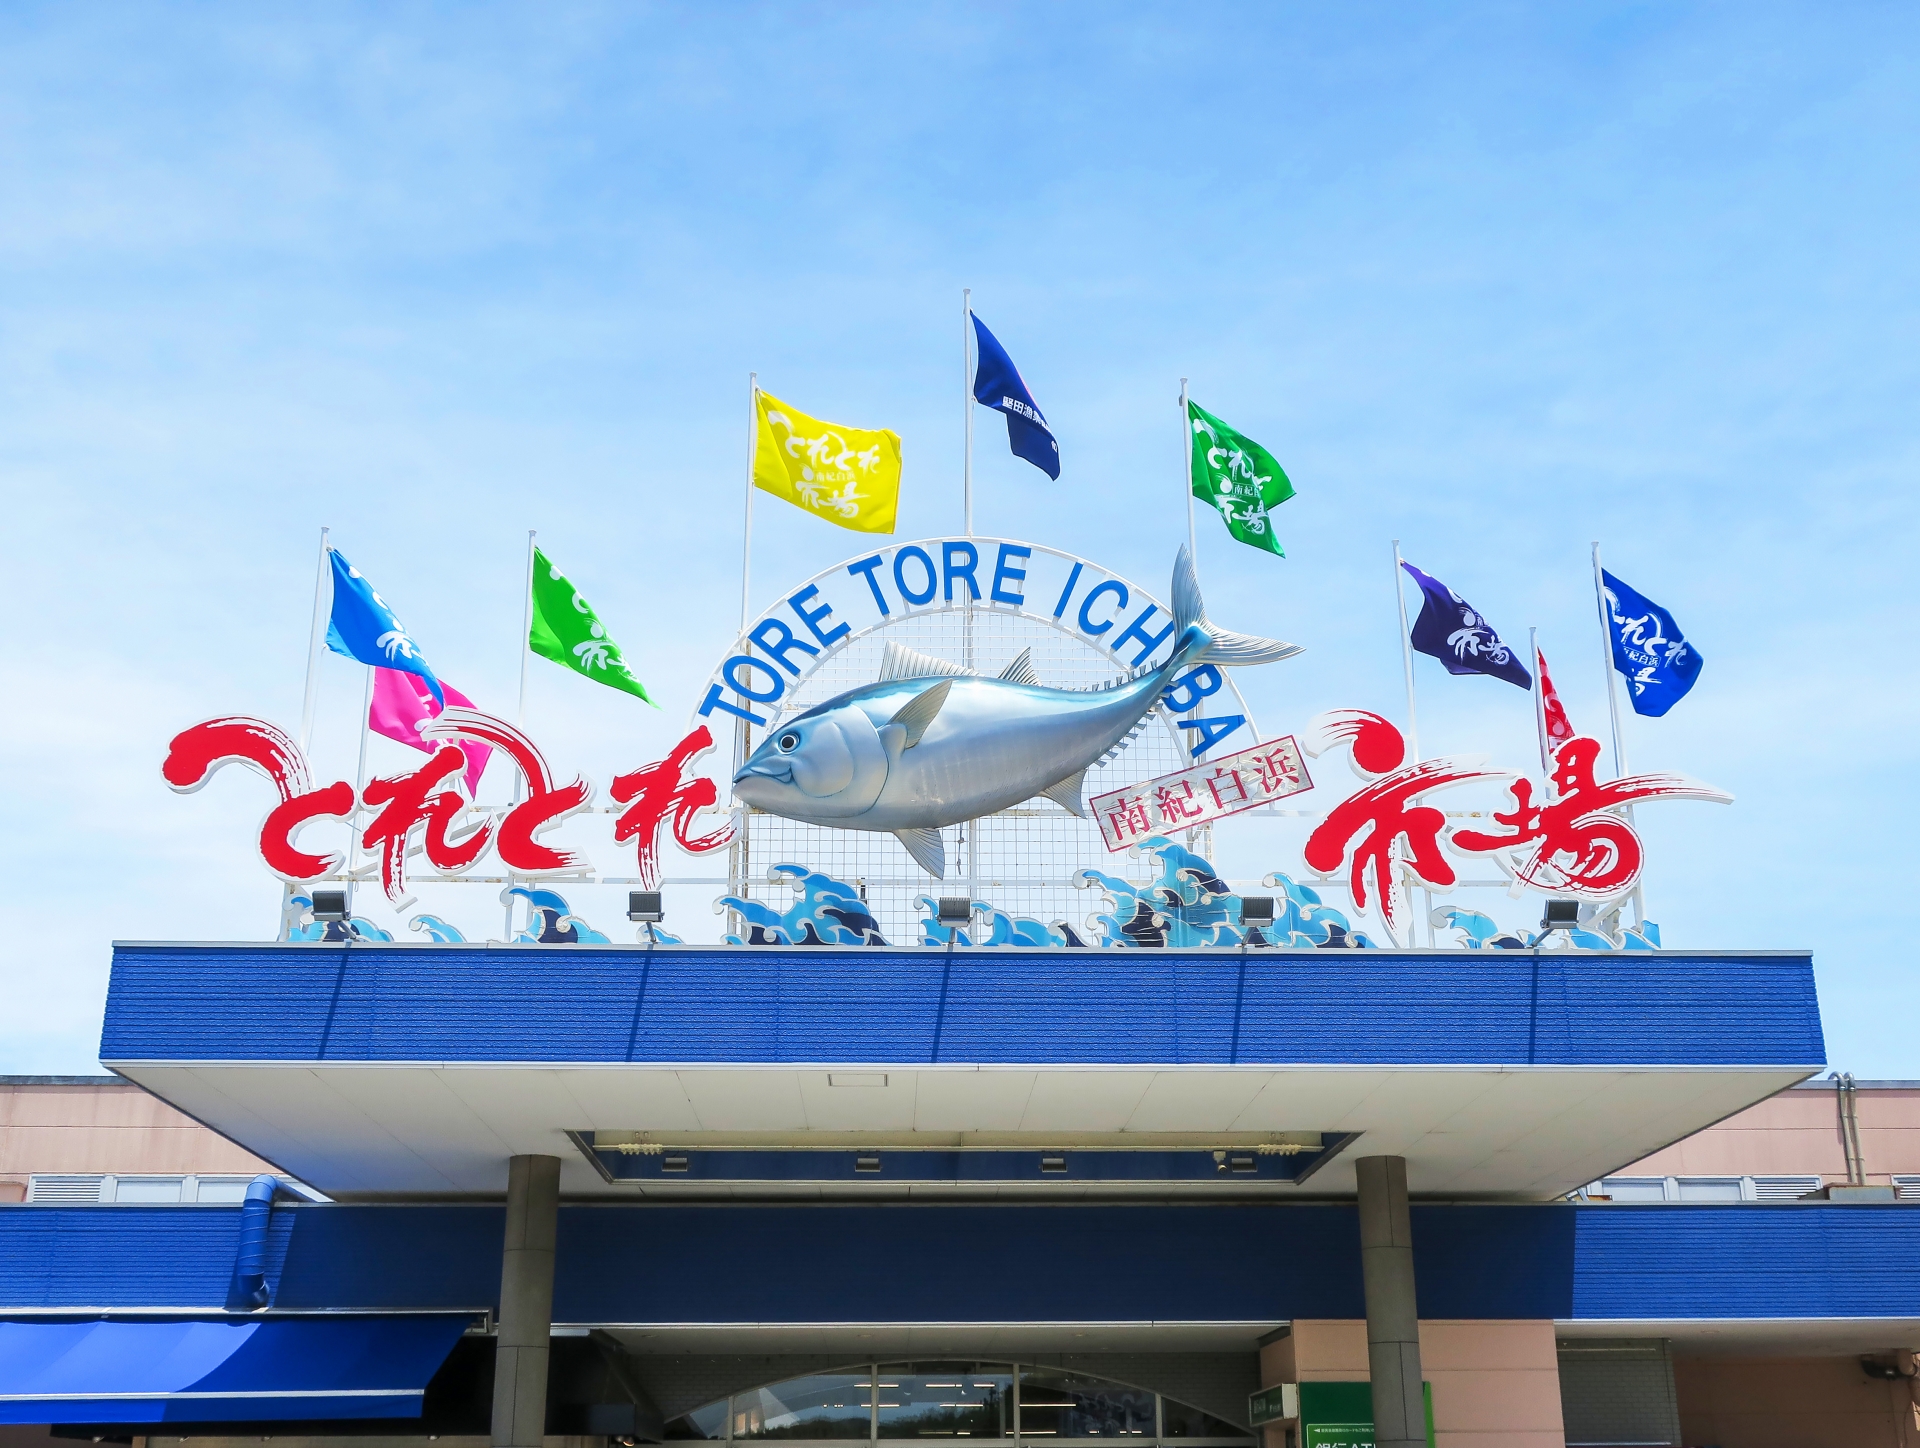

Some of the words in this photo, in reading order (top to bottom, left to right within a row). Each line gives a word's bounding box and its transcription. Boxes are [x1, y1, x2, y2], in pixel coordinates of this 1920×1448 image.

[699, 583, 852, 727] TORE
[847, 541, 1032, 617] TORE
[1053, 562, 1247, 759] ICHBA
[1624, 647, 1659, 667] 紀白浜
[1103, 748, 1300, 840] 南紀白浜
